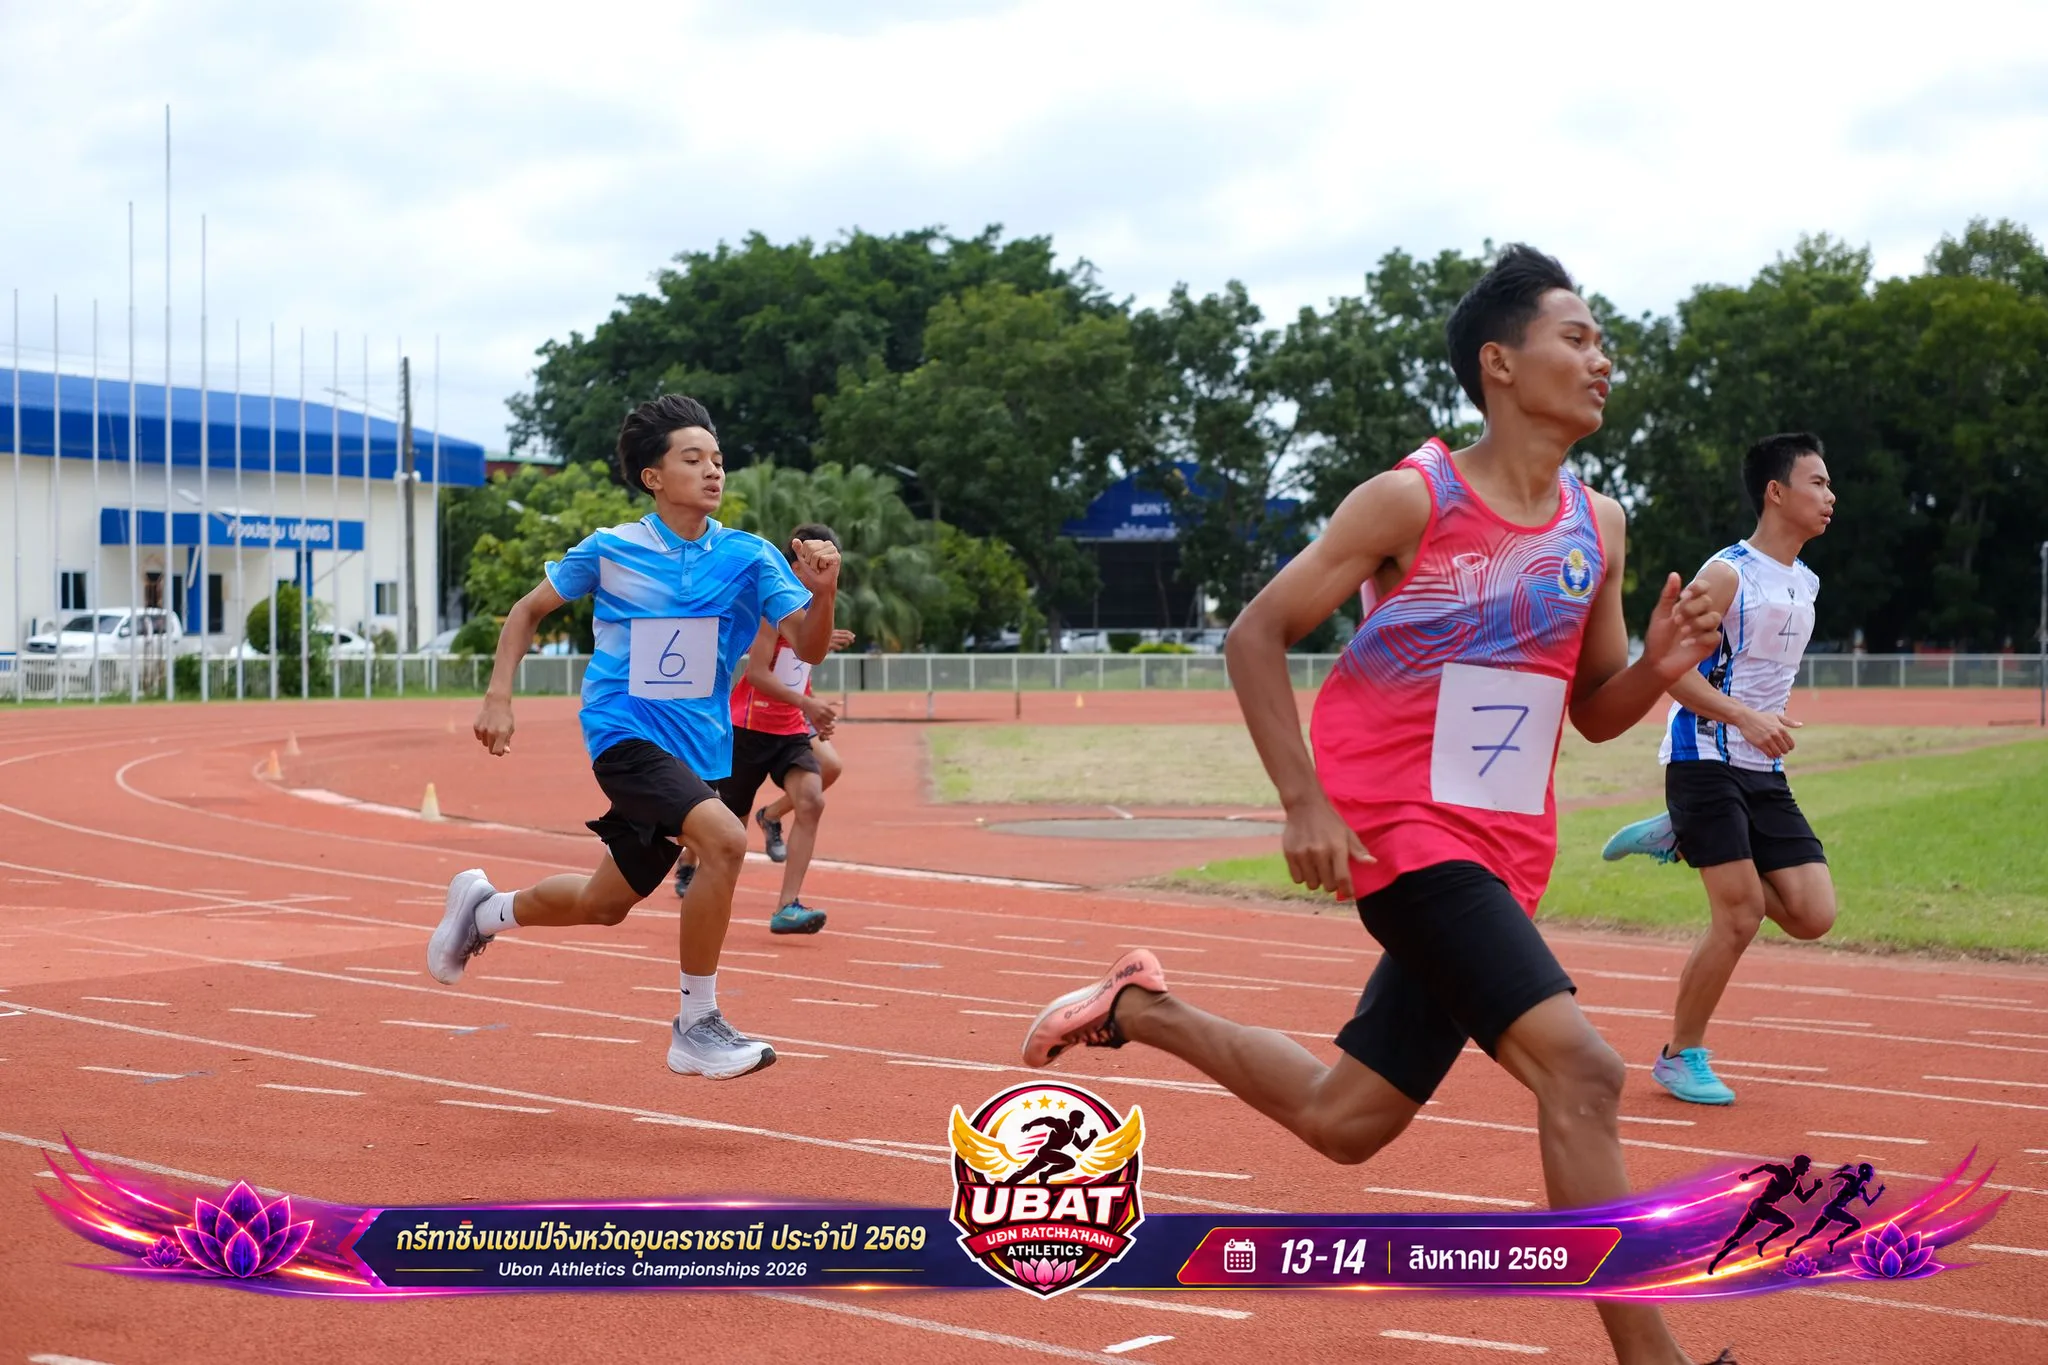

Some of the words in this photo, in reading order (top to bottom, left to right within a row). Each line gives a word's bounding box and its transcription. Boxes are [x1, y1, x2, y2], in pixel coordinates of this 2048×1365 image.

[659, 629, 686, 678] 6
[1778, 611, 1799, 652] 4
[1472, 705, 1529, 777] 7
